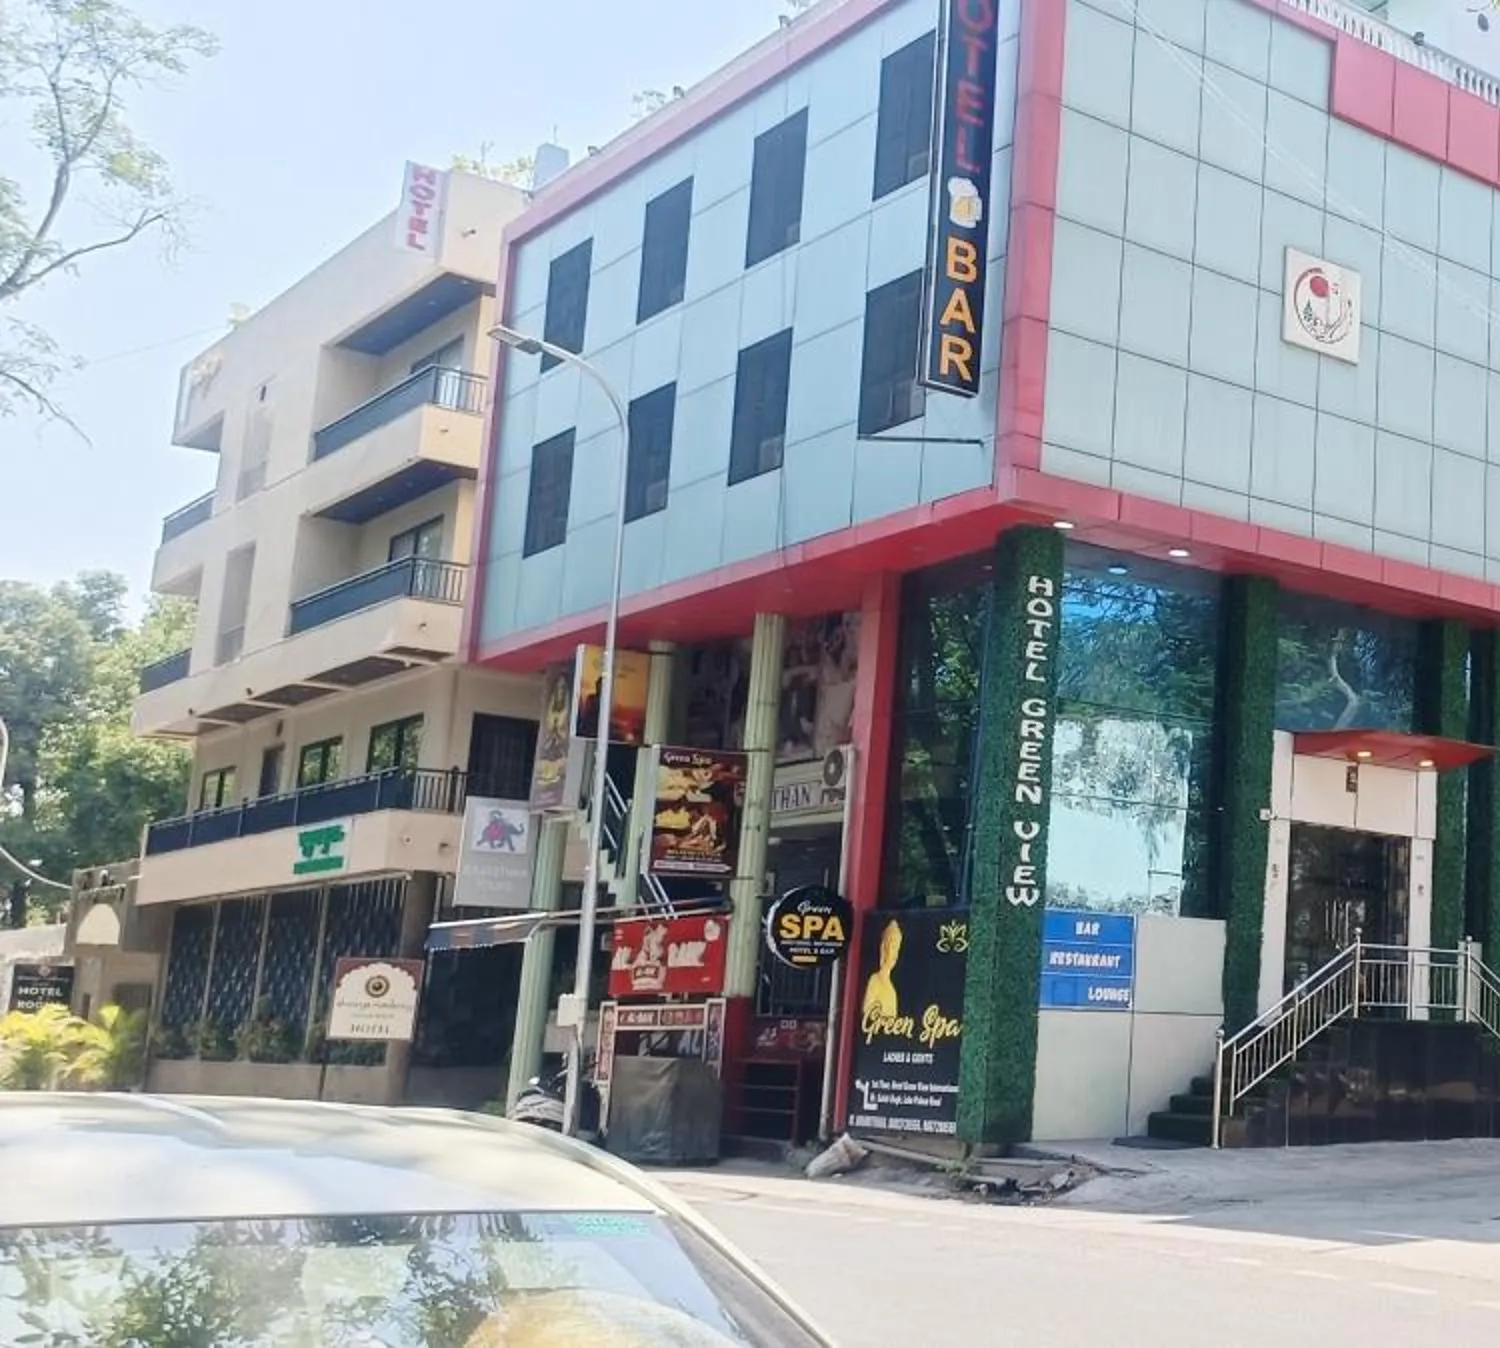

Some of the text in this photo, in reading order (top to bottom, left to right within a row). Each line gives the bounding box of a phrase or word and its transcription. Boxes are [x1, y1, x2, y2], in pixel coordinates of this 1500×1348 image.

[406, 164, 436, 251] HOTEL
[939, 236, 977, 382] BAR
[1005, 575, 1053, 907] HOTEL GREEN VIEW
[779, 913, 845, 941] SPA
[1075, 921, 1101, 937] BAR
[1048, 950, 1121, 969] RESTAURANT
[1087, 985, 1130, 1003] LOUNGE
[861, 1000, 915, 1046] Green
[919, 1004, 963, 1050] Spa
